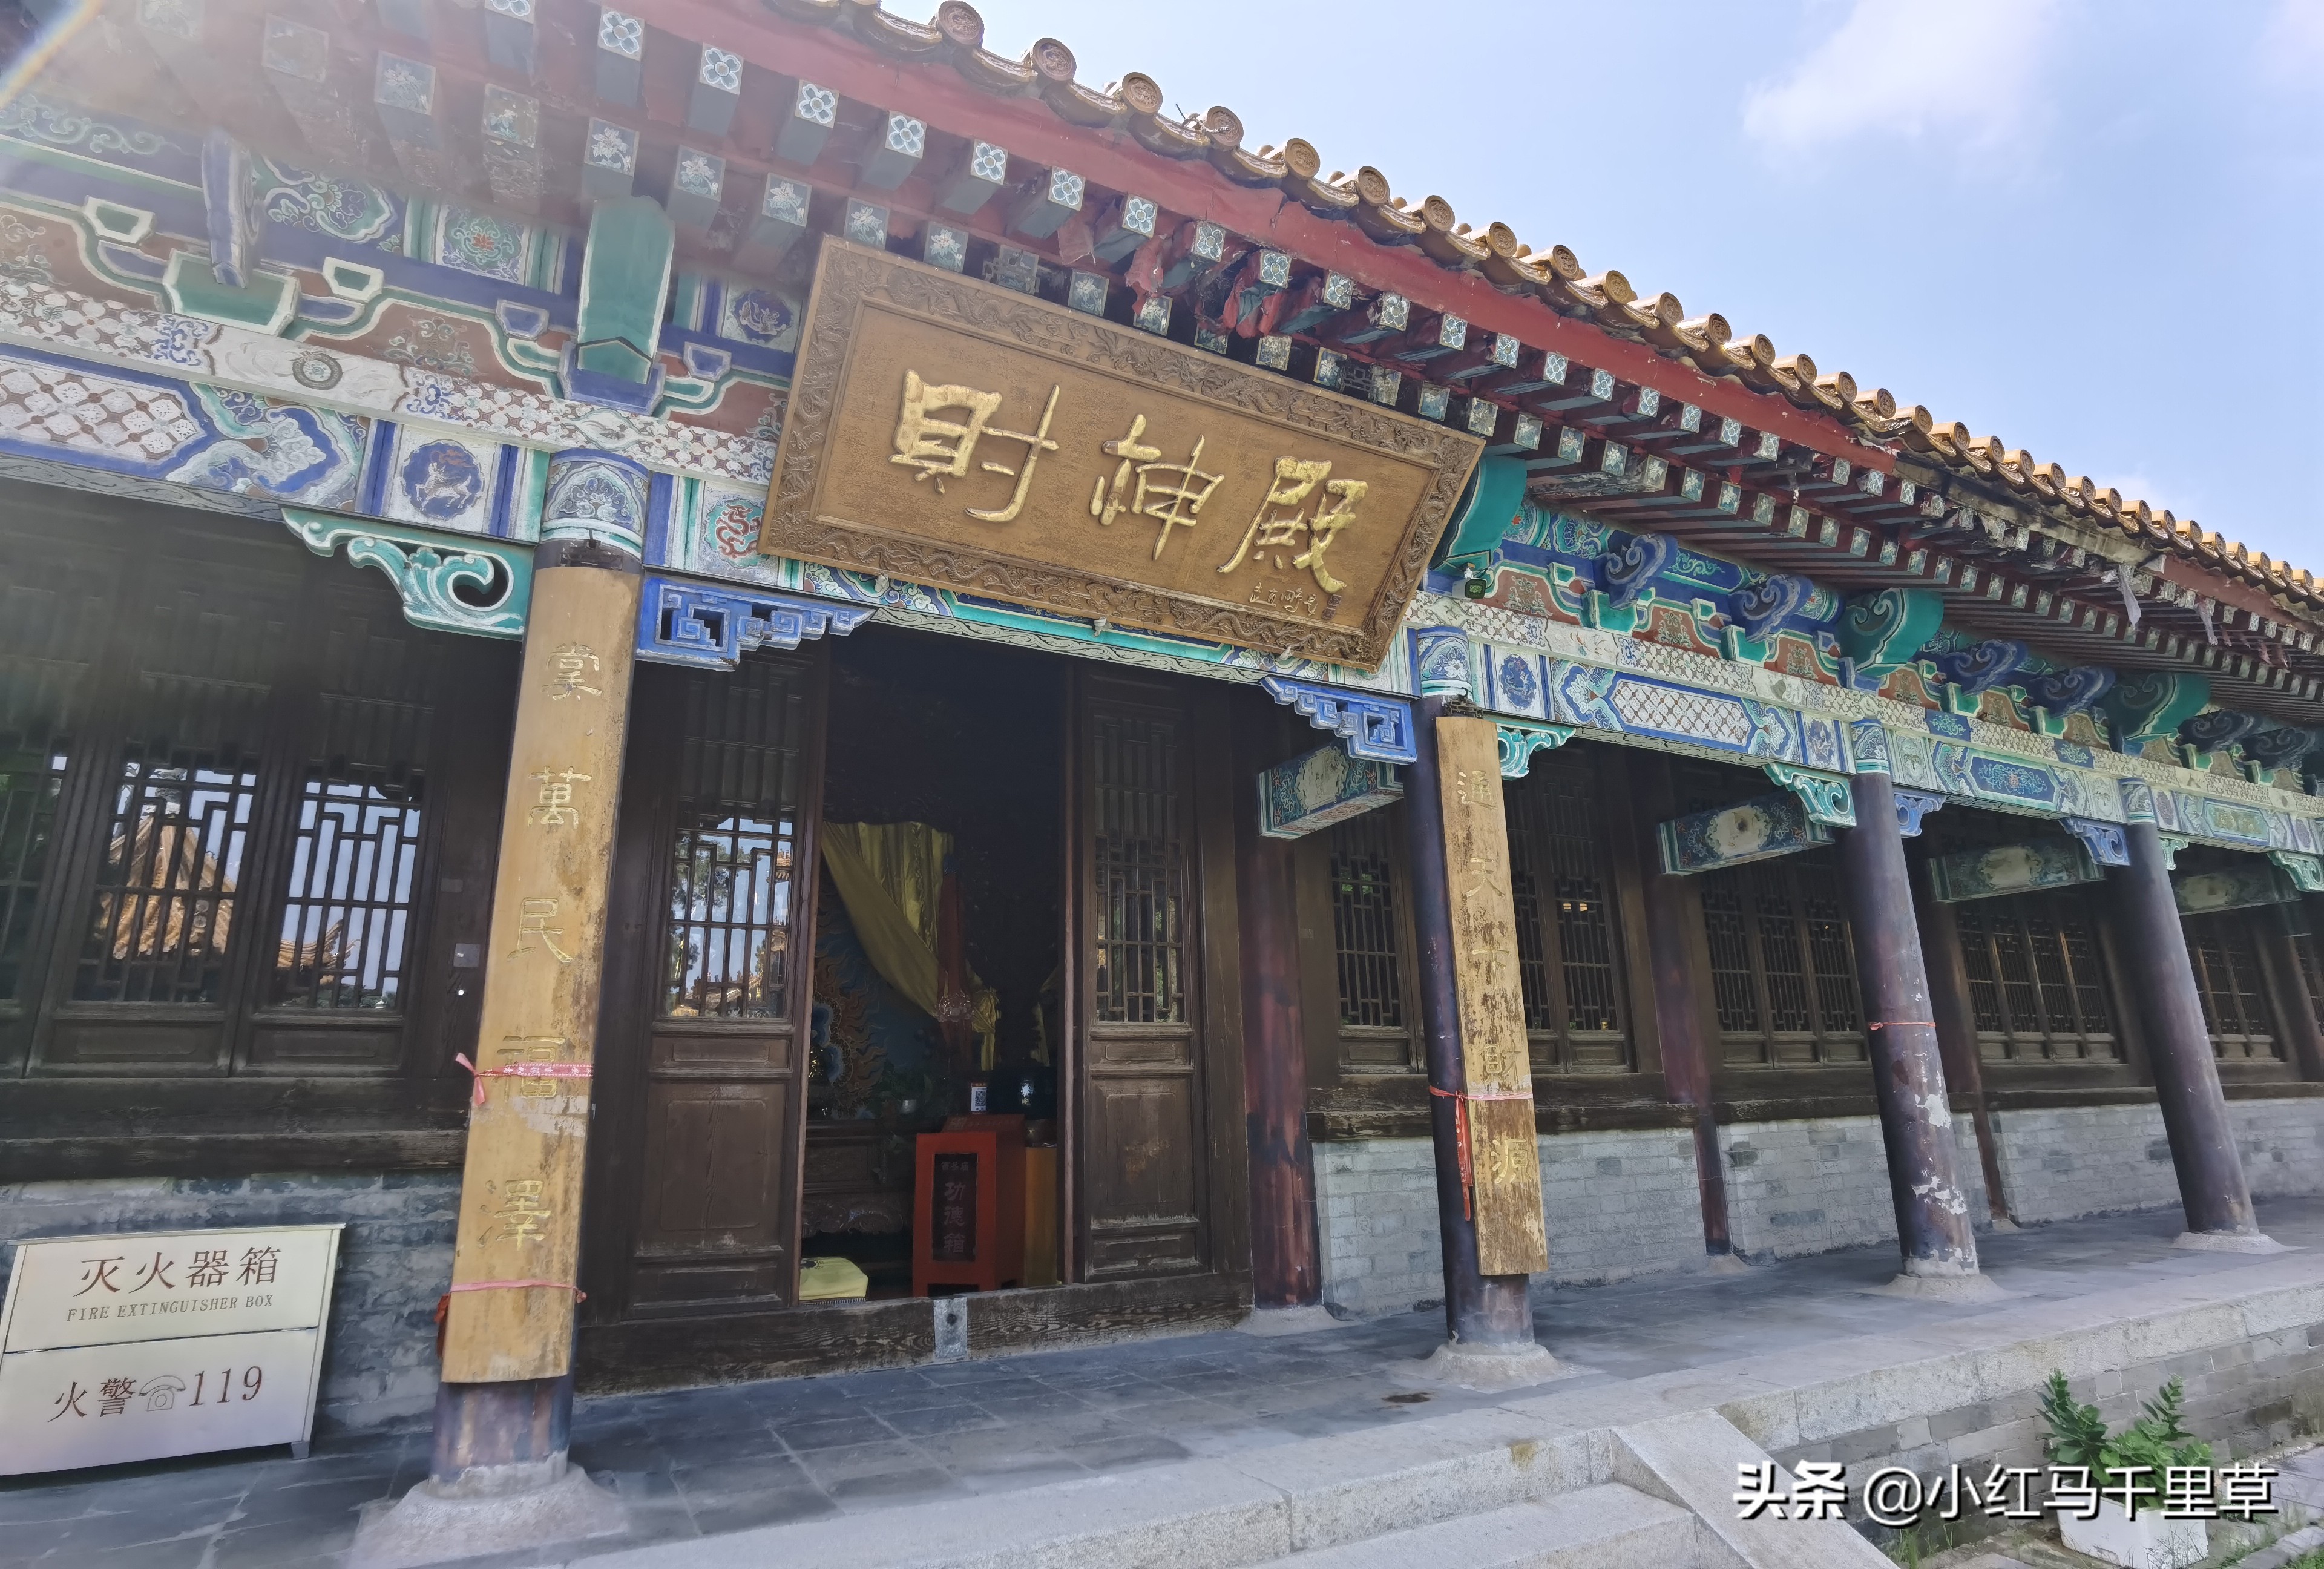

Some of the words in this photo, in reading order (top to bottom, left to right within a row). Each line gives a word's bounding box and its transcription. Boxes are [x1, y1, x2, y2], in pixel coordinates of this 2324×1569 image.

[72, 1246, 281, 1298] 灭火器箱
[66, 1304, 110, 1322] FIRE
[117, 1297, 238, 1318] EXTINGUISHER
[245, 1294, 274, 1308] BOX
[47, 1376, 137, 1423] 火警
[188, 1365, 263, 1407] 119
